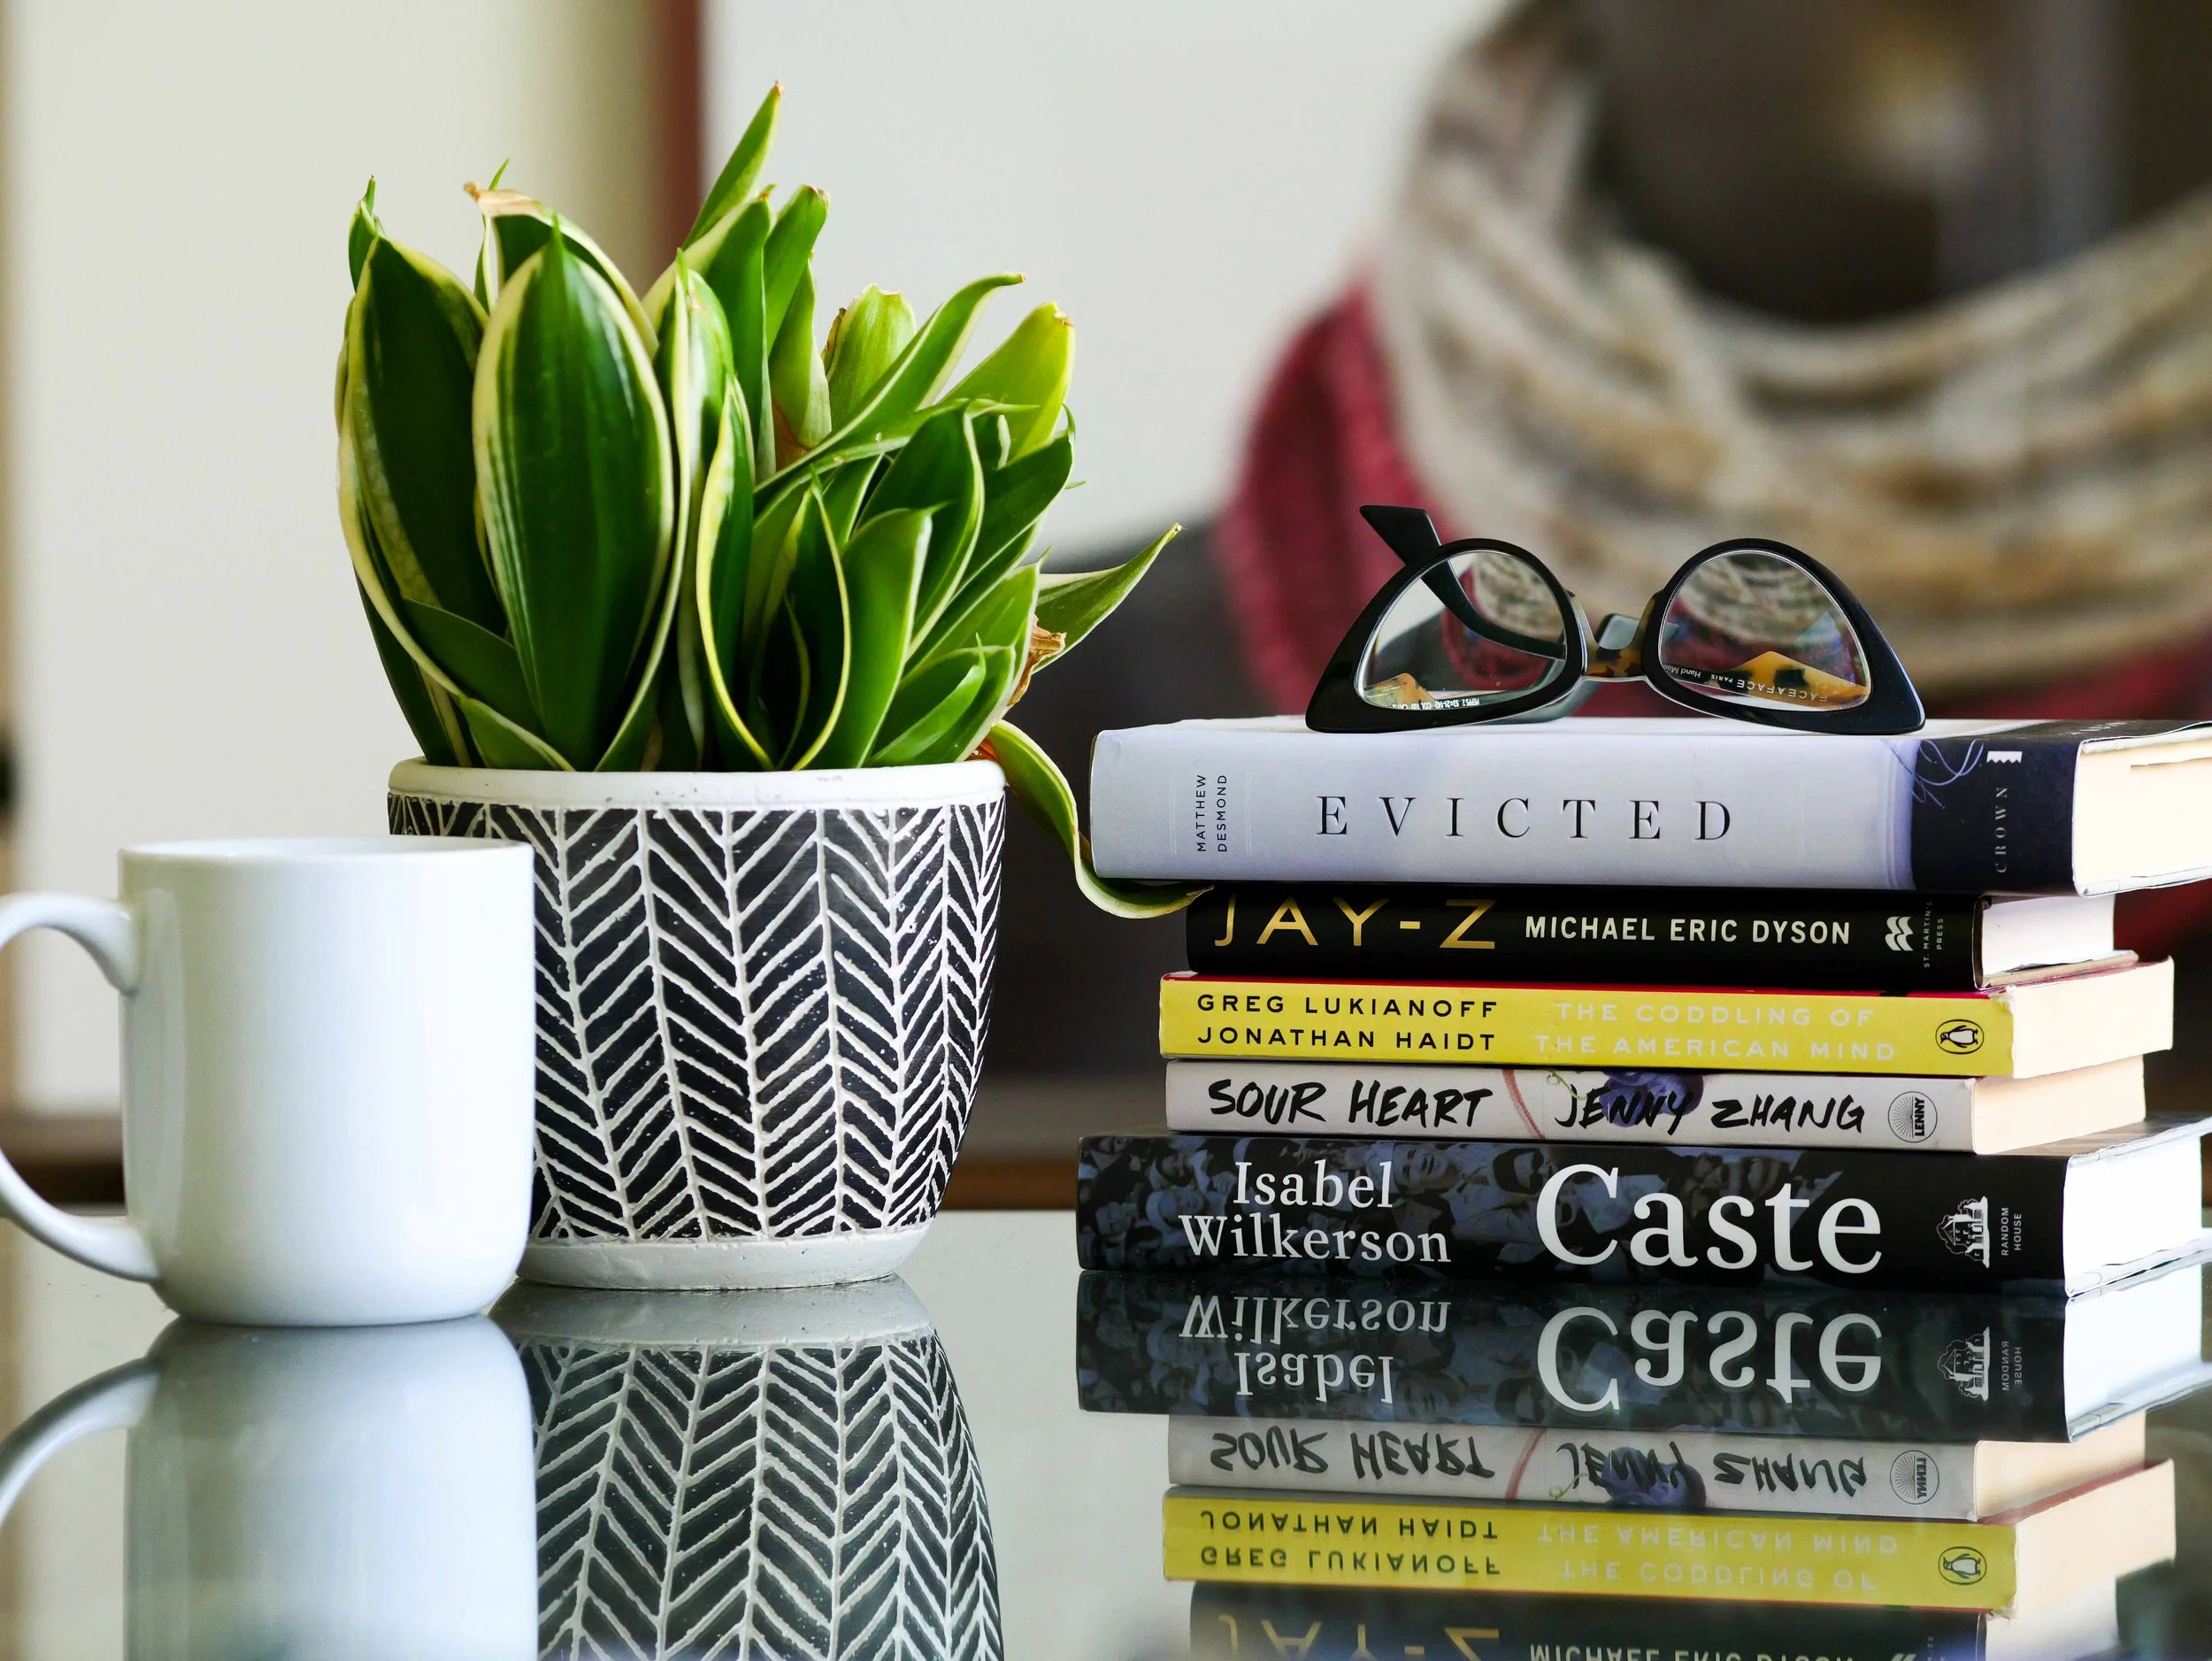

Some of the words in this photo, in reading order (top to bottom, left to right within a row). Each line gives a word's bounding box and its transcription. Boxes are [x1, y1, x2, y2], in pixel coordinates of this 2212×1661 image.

[1681, 668, 1701, 678] Hand
[1196, 773, 1208, 853] MATTHEW
[1217, 774, 1228, 853] DESMOND
[1317, 796, 1731, 840] EVICTED
[1994, 786, 2008, 874] CROWN
[1216, 894, 1495, 949] JAY-Z
[1525, 916, 1655, 942] MICHAEL
[1670, 917, 1739, 942] ERIC
[1752, 919, 1852, 946] DYSON
[1936, 917, 1945, 950] PRESS
[1197, 993, 1286, 1015] GREG
[1304, 996, 1498, 1019] LUKIANOFF
[1557, 1003, 1618, 1021] THE
[1636, 1004, 1811, 1026] CODDLING
[1830, 1008, 1875, 1027] OF
[1197, 1026, 1374, 1050] JONATHAN
[1395, 1031, 1495, 1051] HAIDT
[1535, 1035, 1595, 1054] THE
[1611, 1036, 1788, 1060] AMERICAN
[1811, 1042, 1895, 1061] MIND
[1208, 1080, 1326, 1125] SOUR
[1348, 1080, 1493, 1127] HEART
[1554, 1084, 1690, 1135] JENNY
[1711, 1094, 1864, 1133] ZHANG
[1912, 1098, 1926, 1137] LENNY
[1233, 1160, 1393, 1208] Isabel
[1179, 1212, 1451, 1262] Wilkerson
[1536, 1164, 1882, 1273] Caste
[2001, 1205, 2010, 1257] RANDOM
[2013, 1211, 2023, 1252] HOUSE
